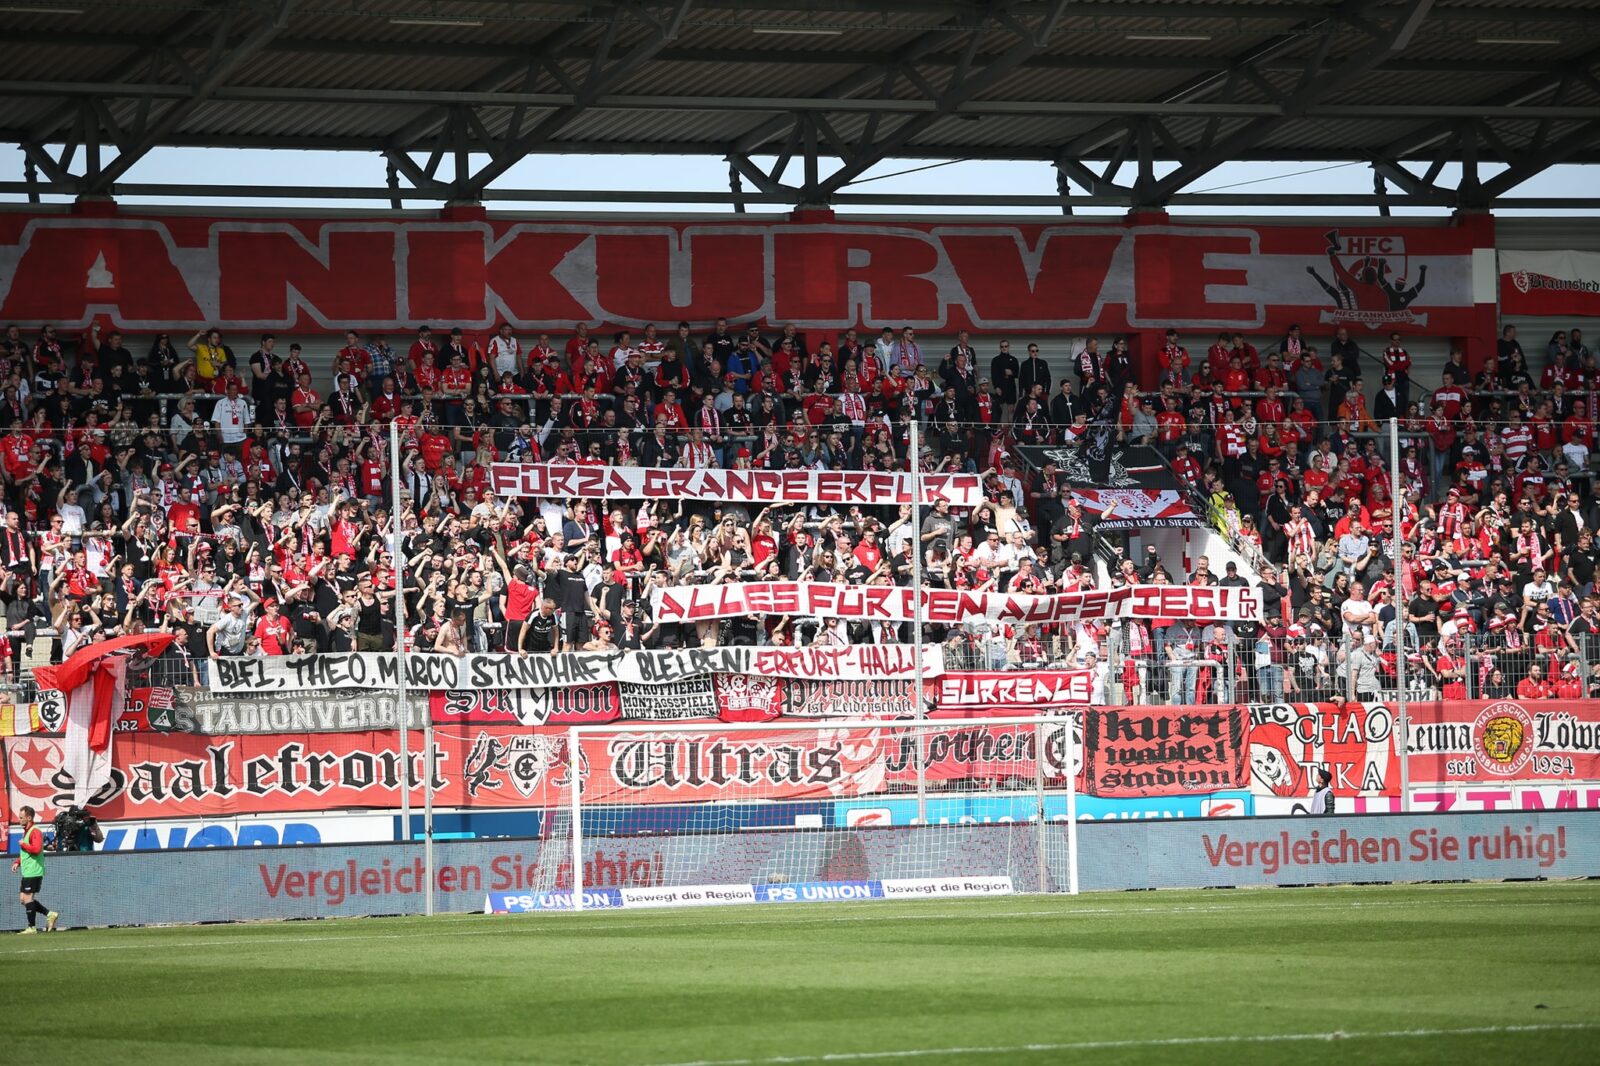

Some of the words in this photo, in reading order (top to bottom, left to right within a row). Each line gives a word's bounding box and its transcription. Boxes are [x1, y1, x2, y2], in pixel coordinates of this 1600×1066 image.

[1347, 237, 1393, 254] HFC
[492, 464, 633, 496] FORZA
[642, 469, 808, 501] GRANDE
[817, 472, 979, 504] ERFURT
[1137, 519, 1151, 527] UM
[1154, 519, 1166, 527] ZU
[658, 583, 800, 619] ALLES
[807, 584, 894, 618] FÜR
[902, 588, 987, 622] DEN
[998, 586, 1228, 622] AUFSTIEG!
[377, 654, 458, 689] MARCO
[471, 651, 626, 688] STANDHAFT
[621, 680, 712, 695] BOYKOTTIEREN
[942, 675, 1089, 704] SURREALE
[622, 695, 714, 709] MONTAGSSPIELE
[831, 697, 913, 713] Leidenschaft
[625, 708, 652, 719] NICHT
[1476, 703, 1530, 728] HALLESCHER
[1294, 706, 1393, 747] CHAO
[609, 734, 842, 789] Ultras
[1447, 756, 1476, 775] seit
[1532, 755, 1574, 774] 1984
[1202, 829, 1400, 875] Vergleichen
[1409, 828, 1460, 862] Sie
[1468, 825, 1568, 868] ruhig!
[259, 856, 481, 906] Vergleichen
[887, 883, 937, 894] bewegt
[941, 882, 959, 892] die
[964, 881, 1010, 893] Region
[628, 892, 678, 903] bewegt
[682, 890, 702, 901] die
[706, 888, 752, 901] Region
[768, 887, 797, 900] PS
[803, 884, 870, 899] UNION
[504, 896, 535, 909] PS
